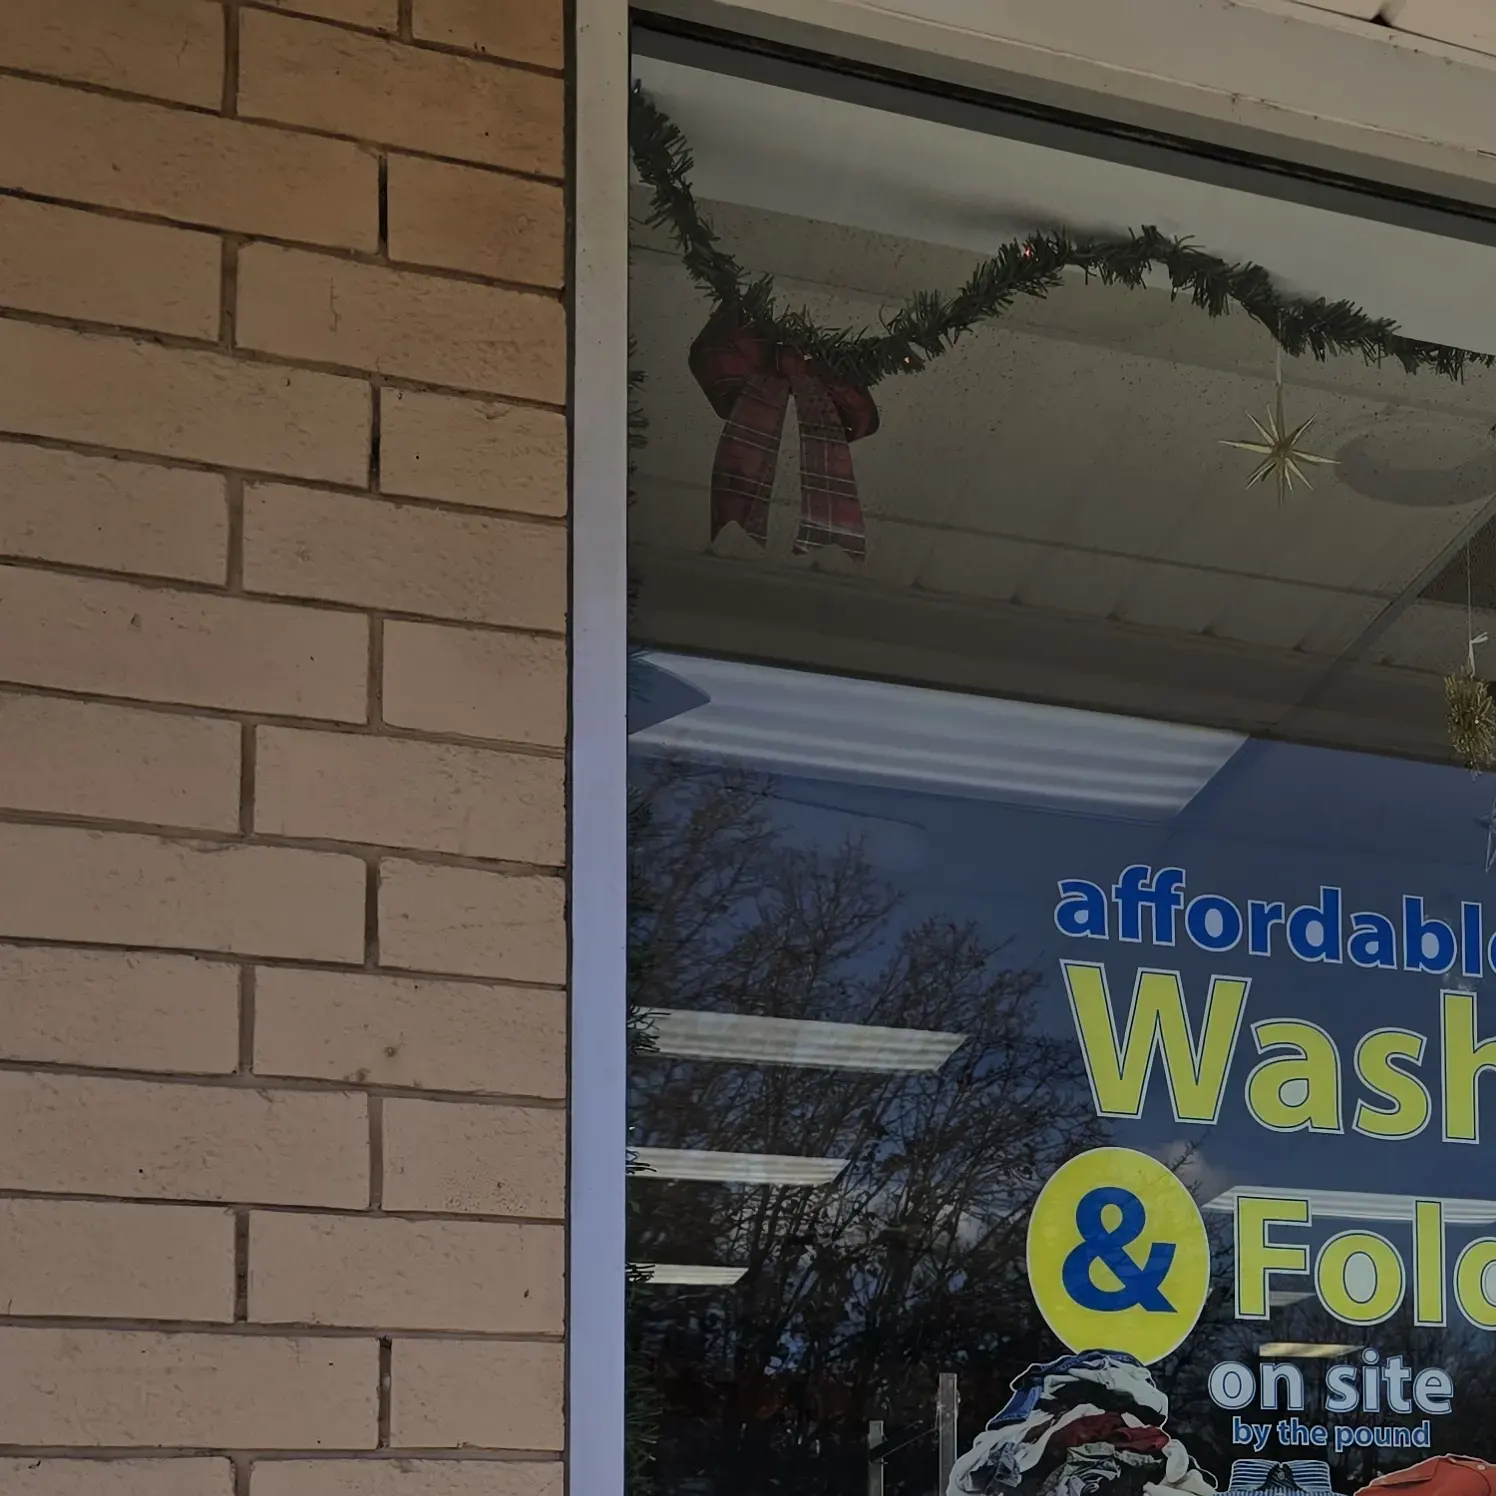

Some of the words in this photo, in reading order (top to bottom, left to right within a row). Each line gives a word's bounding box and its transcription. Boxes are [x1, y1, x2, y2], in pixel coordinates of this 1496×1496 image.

[1061, 1186, 1178, 1314] &
[1209, 1360, 1305, 1411] on
[1324, 1347, 1454, 1415] site
[1232, 1416, 1273, 1453] by
[1277, 1417, 1328, 1446] the
[1334, 1420, 1431, 1453] pound
